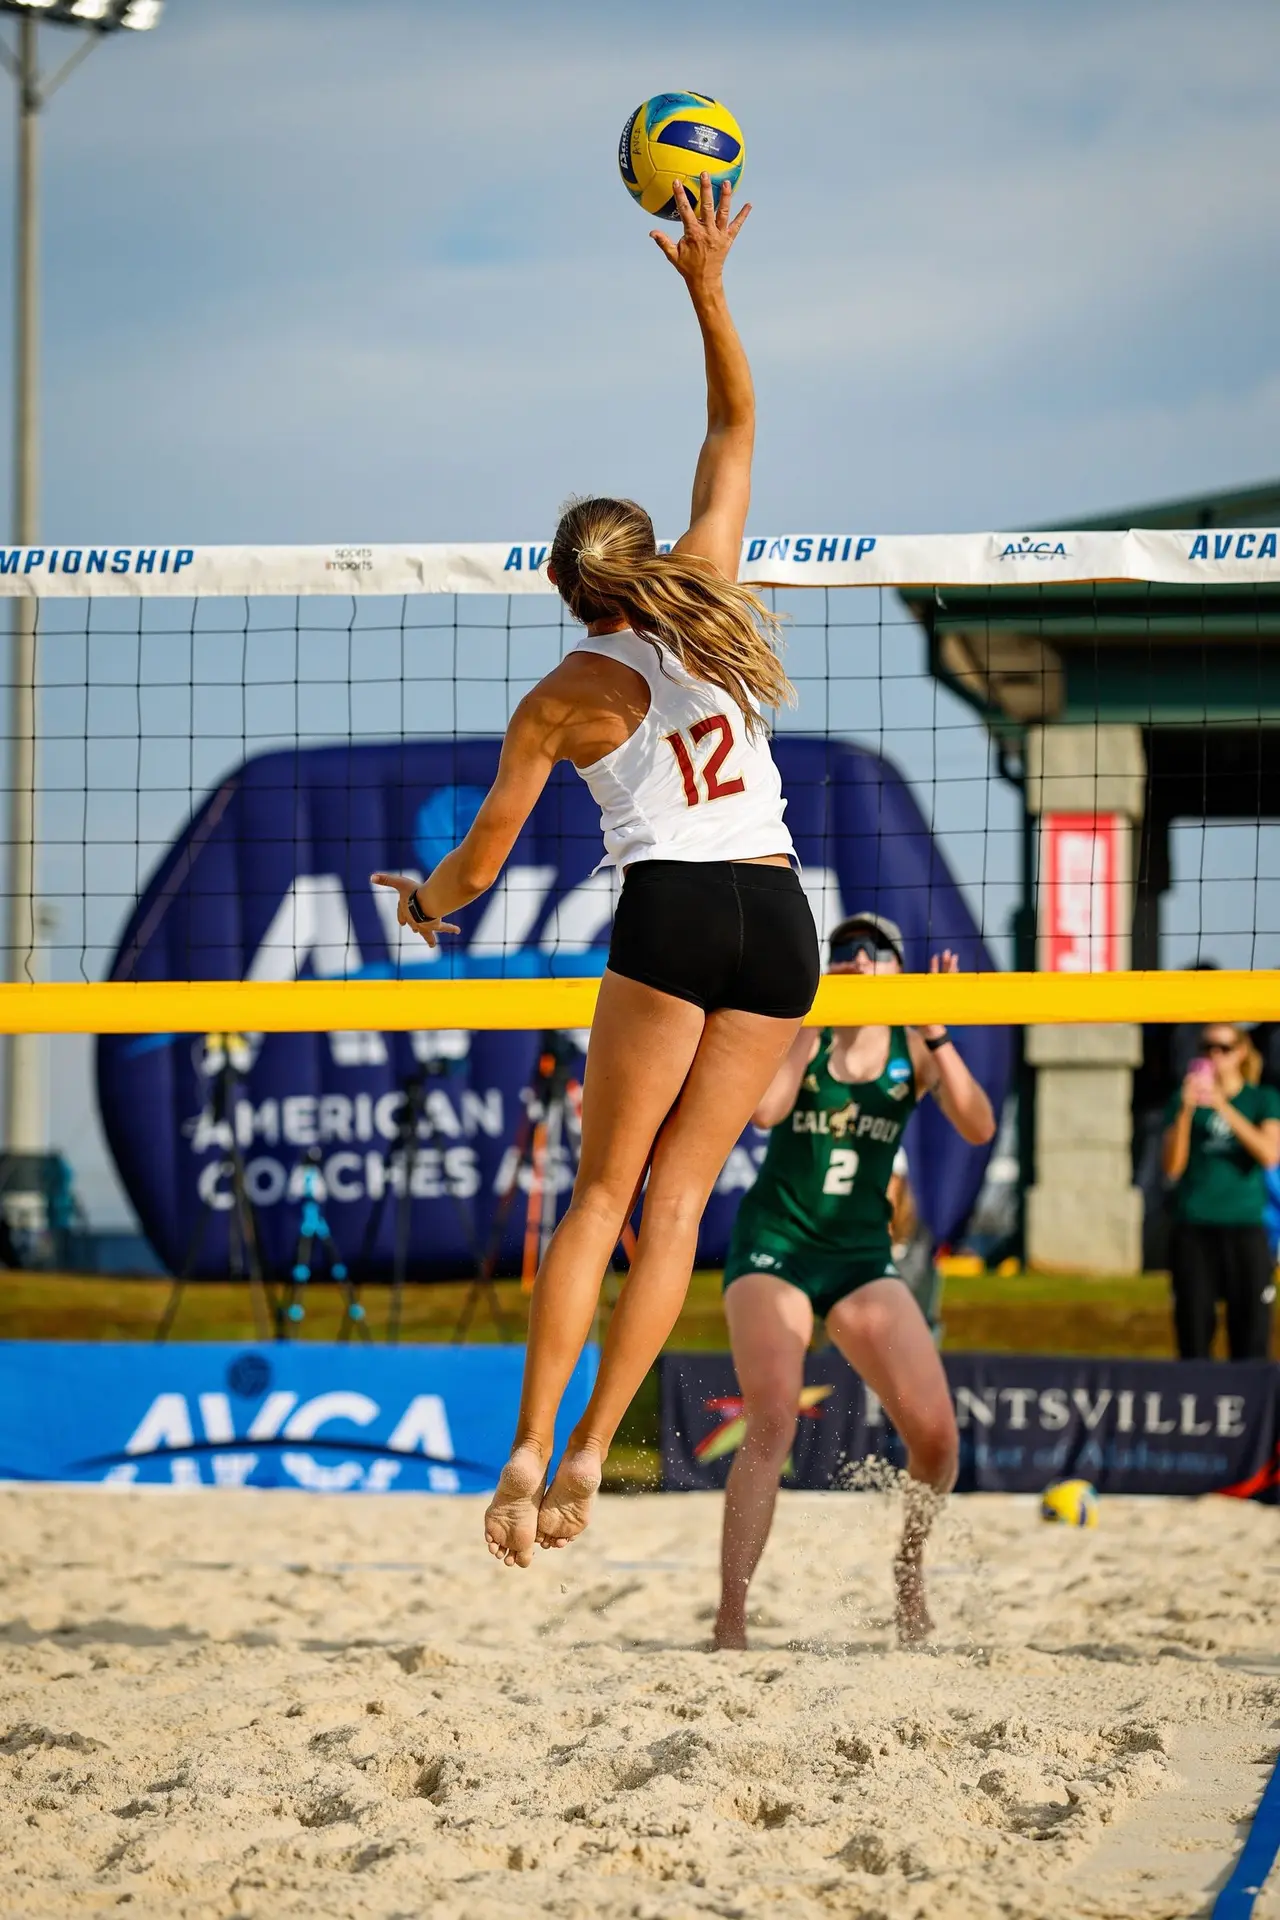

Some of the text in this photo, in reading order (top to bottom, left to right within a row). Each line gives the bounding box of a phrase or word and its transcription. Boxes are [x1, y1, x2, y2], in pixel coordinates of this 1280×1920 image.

[503, 547, 547, 571] AV
[1001, 541, 1067, 560] AVCA
[1189, 533, 1277, 560] AVCA
[659, 712, 746, 809] 12
[793, 1110, 830, 1134] CAL
[822, 1148, 859, 1195] 2
[864, 1385, 1247, 1437] NTSVILLE
[104, 1391, 460, 1491] AVCA
